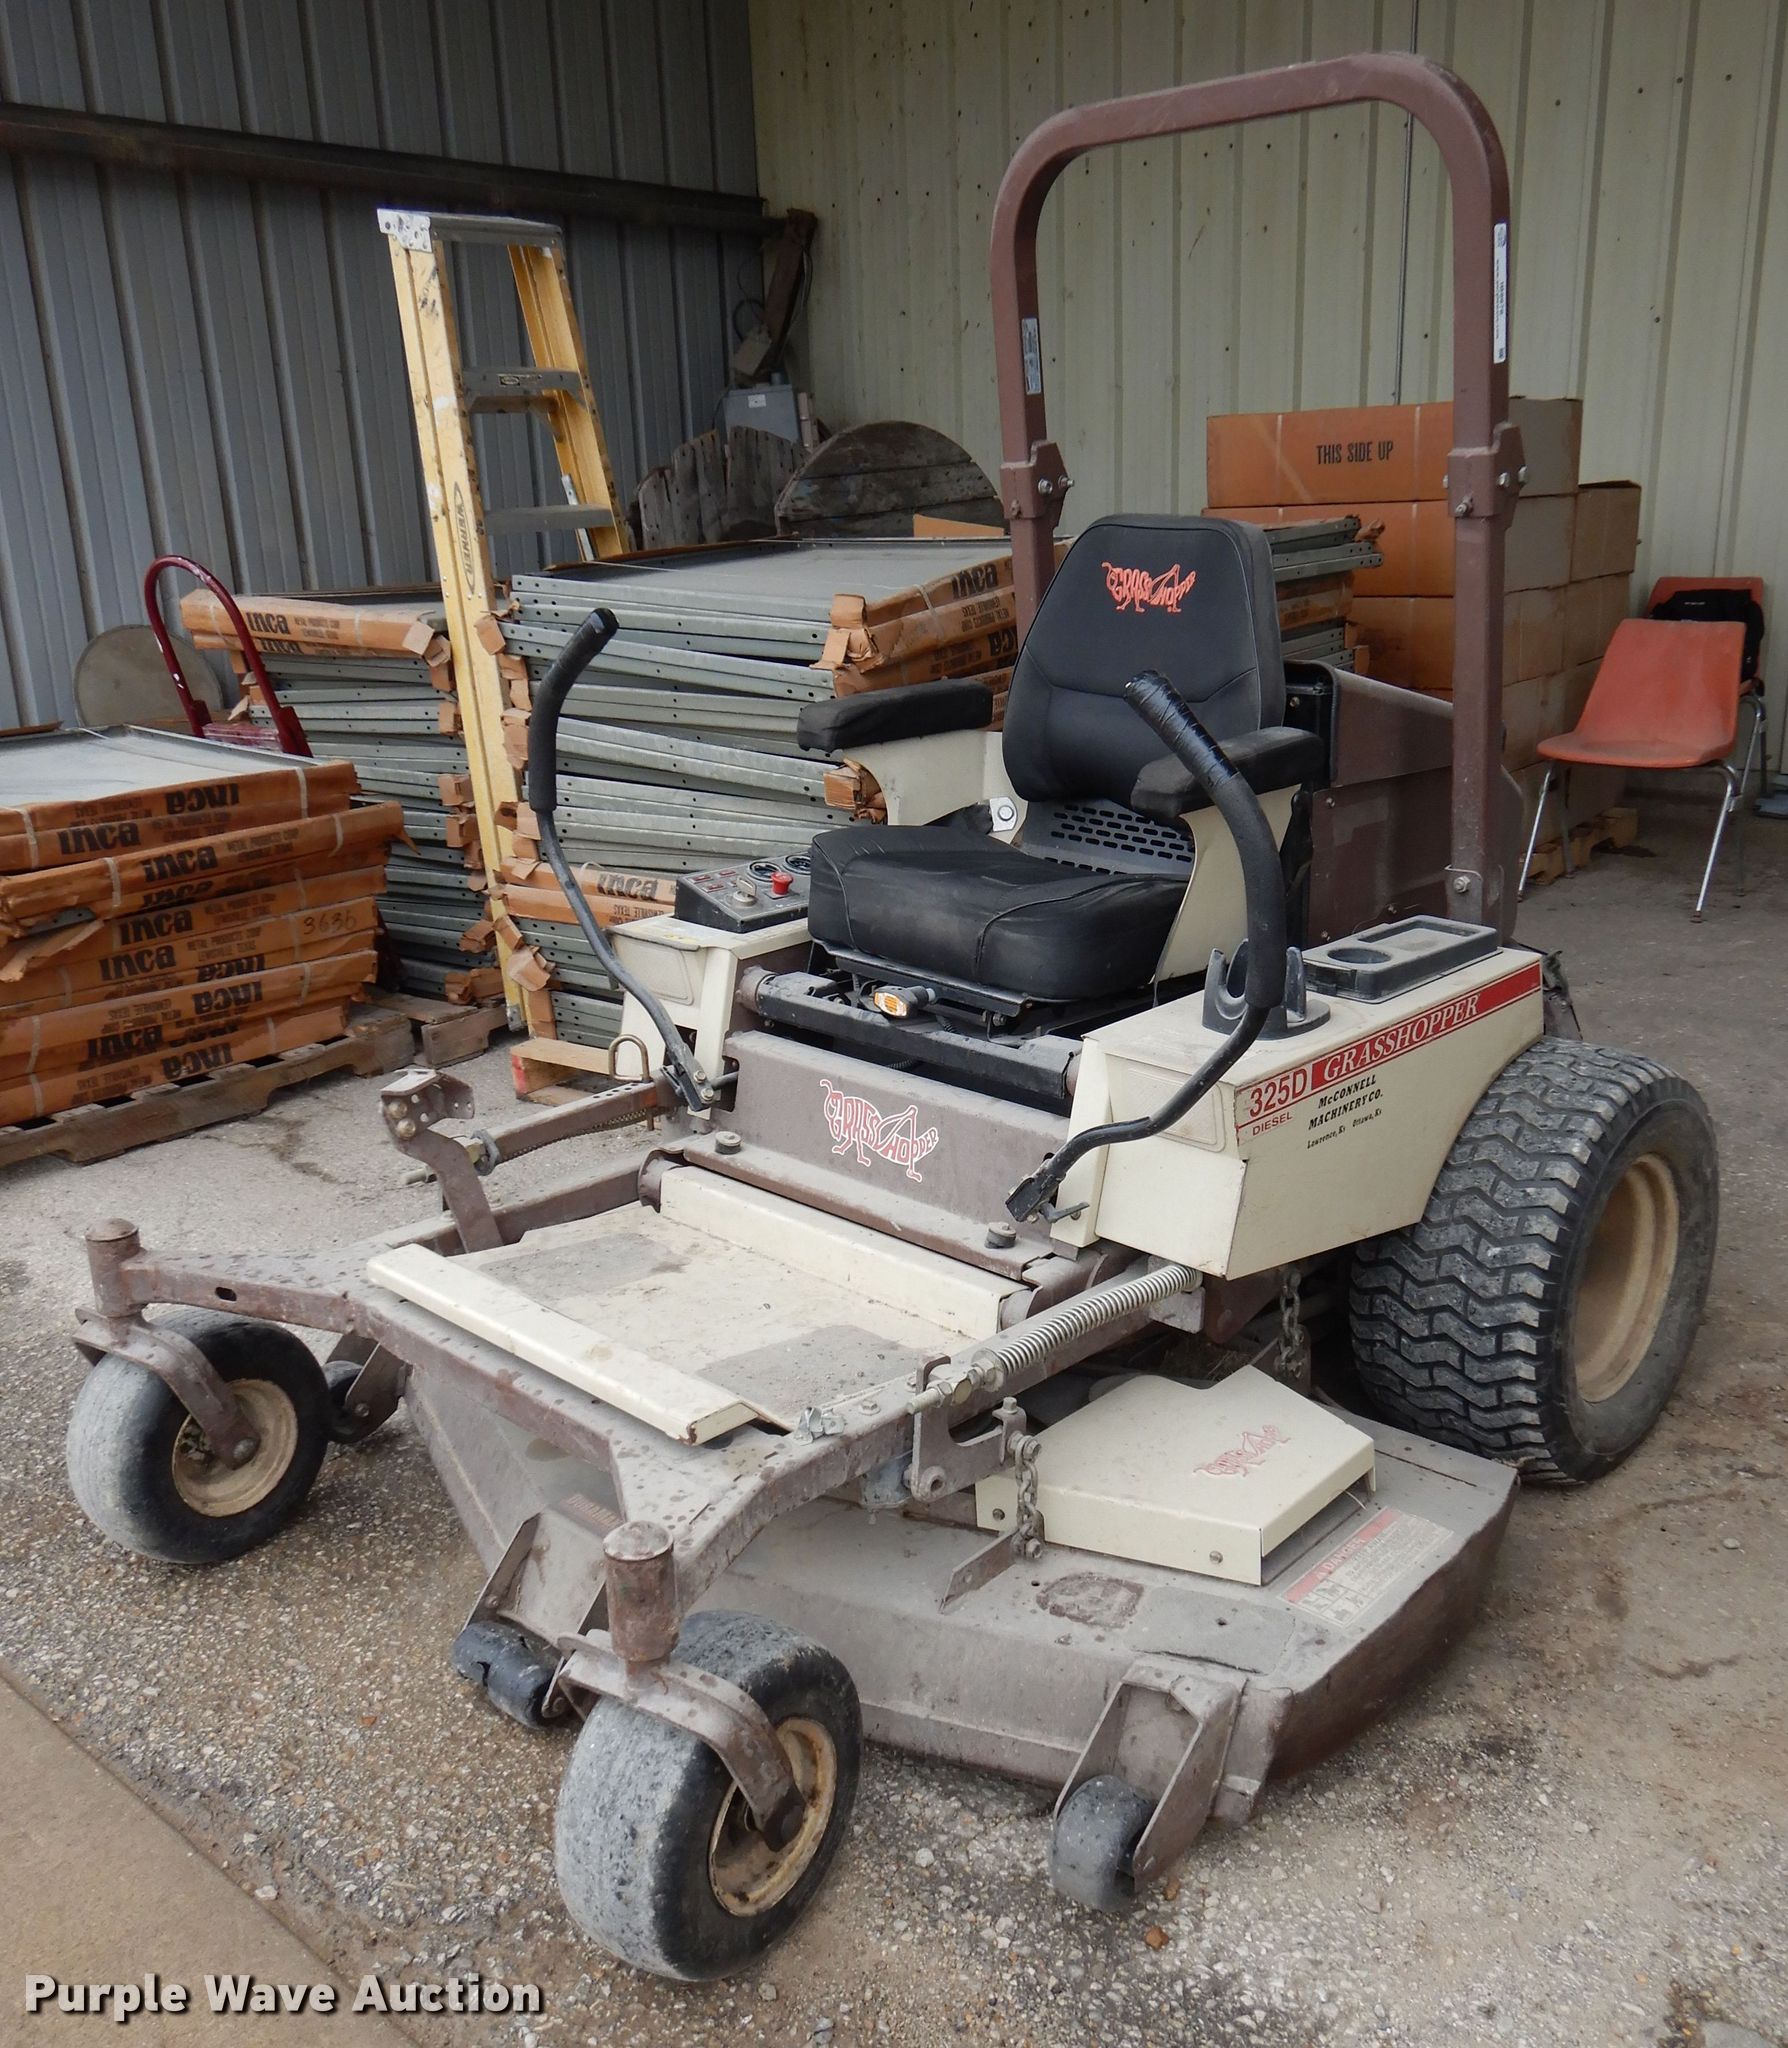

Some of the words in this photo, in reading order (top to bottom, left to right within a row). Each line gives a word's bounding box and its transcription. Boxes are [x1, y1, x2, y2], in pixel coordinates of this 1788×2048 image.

[1316, 443, 1342, 465] THIS
[1347, 441, 1373, 463] SIDE
[1378, 440, 1394, 461] UP
[1249, 1067, 1308, 1118] 325D
[1323, 993, 1480, 1082] GRASSHOPPER
[1318, 1073, 1377, 1109] McCONNELL
[1251, 1110, 1293, 1137] DIESEL
